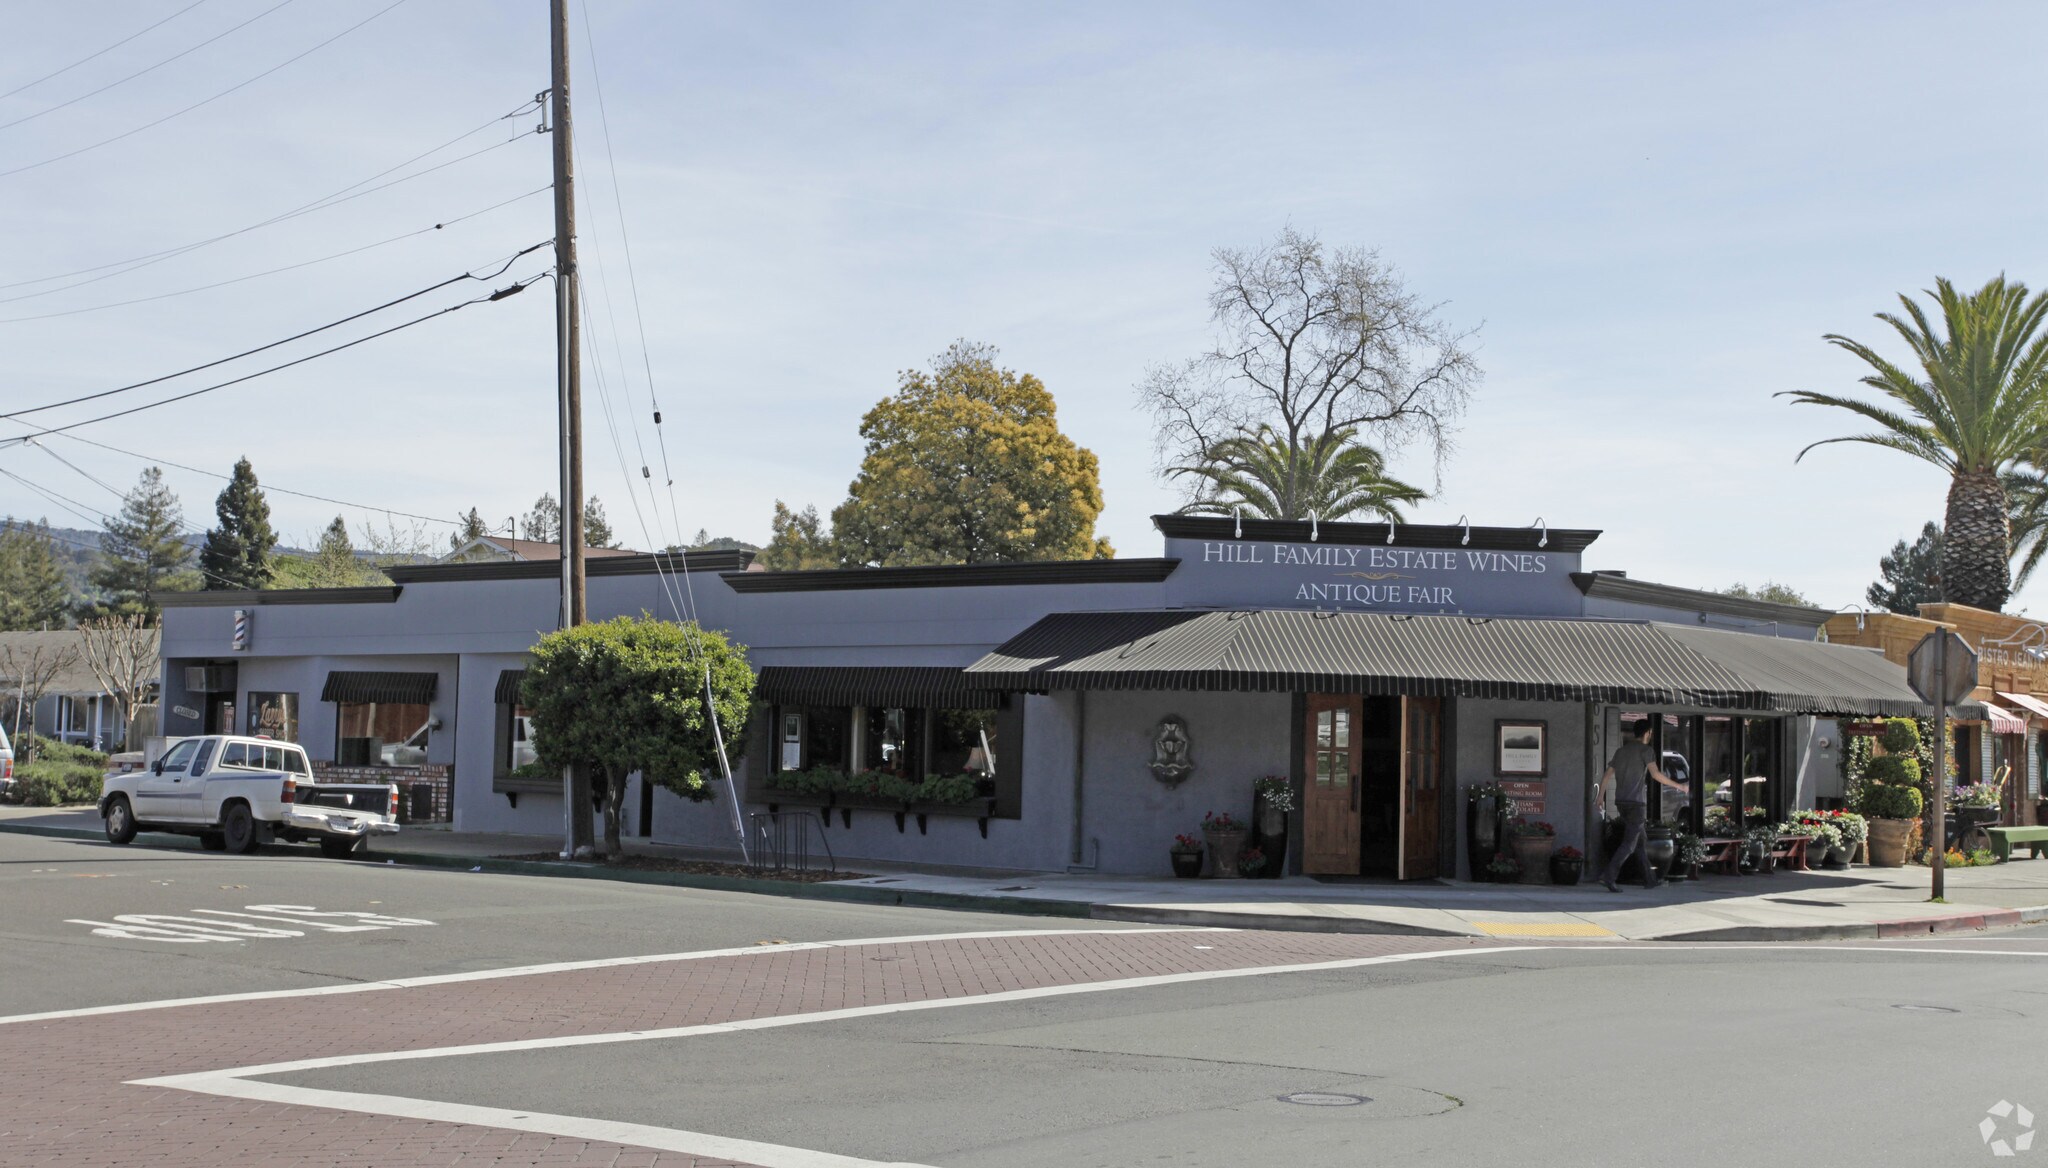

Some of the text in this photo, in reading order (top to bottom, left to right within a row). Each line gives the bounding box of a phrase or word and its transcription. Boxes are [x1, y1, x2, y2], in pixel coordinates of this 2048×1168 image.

[1203, 542, 1546, 573] HILL FAMILY ESTATE WINES
[1295, 583, 1456, 605] ANTIQUE FAIR
[1977, 646, 2009, 666] BISTRO
